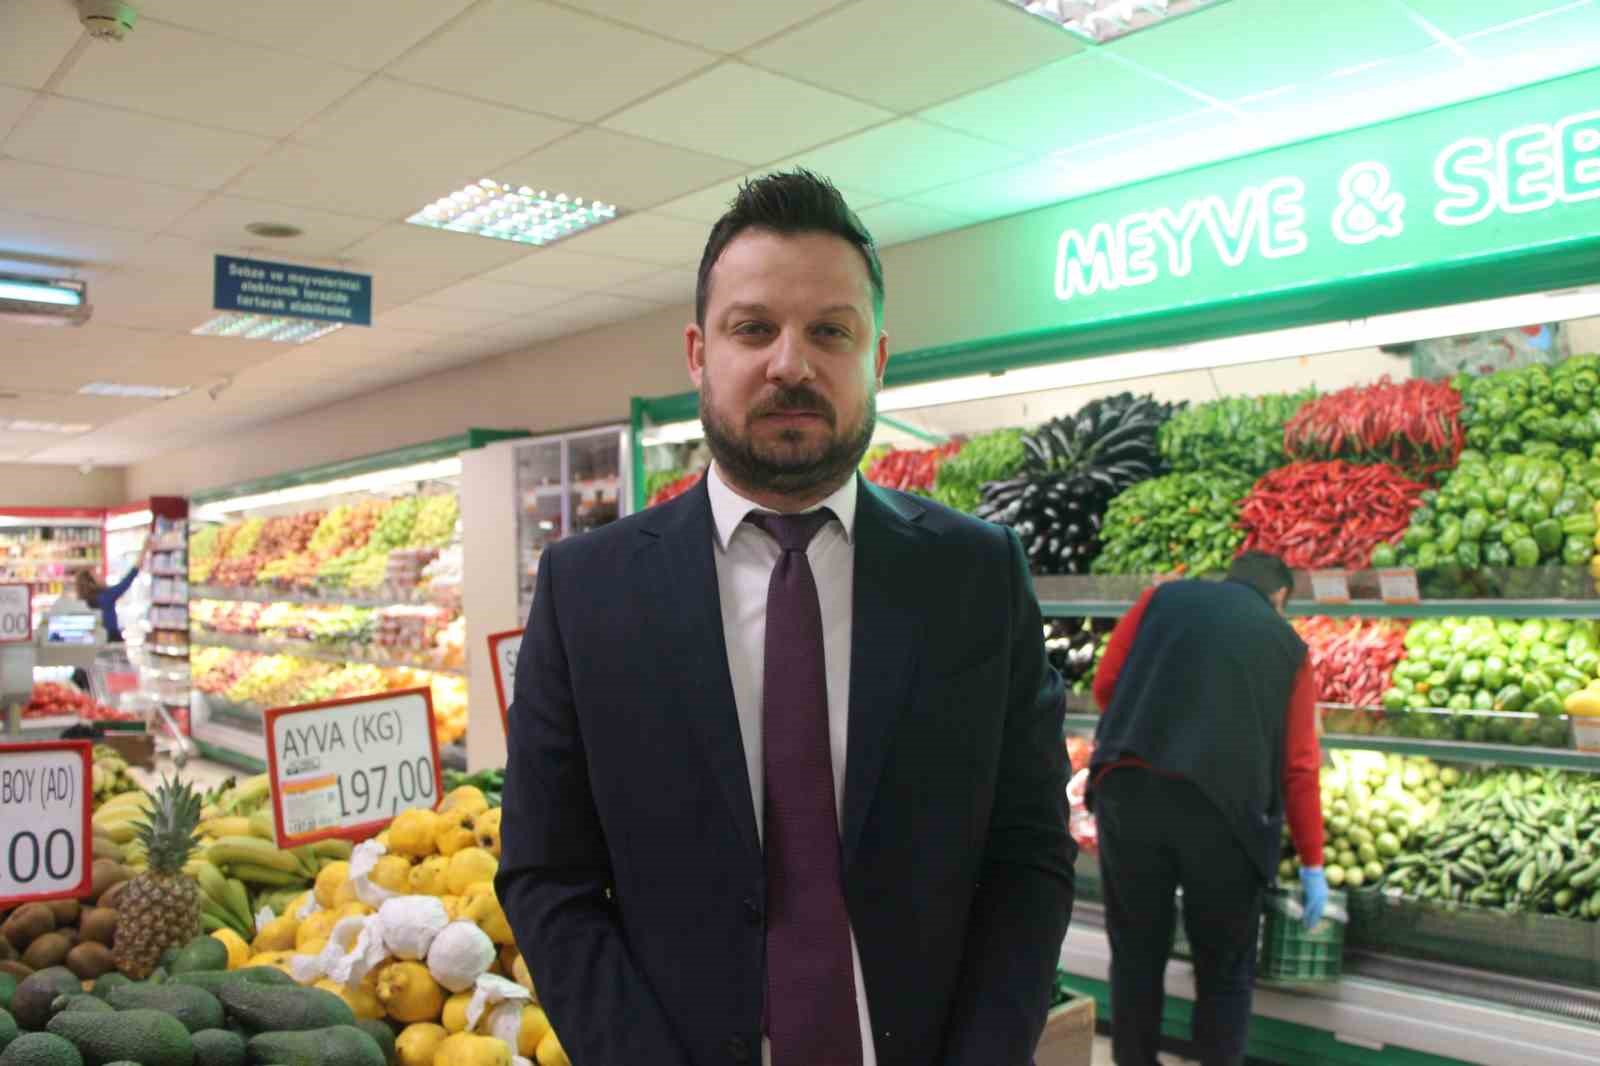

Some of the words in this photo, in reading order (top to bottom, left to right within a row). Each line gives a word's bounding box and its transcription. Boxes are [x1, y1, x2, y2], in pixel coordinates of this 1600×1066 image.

[1055, 177, 1307, 299] MEYVE
[1332, 161, 1405, 245] &
[1434, 109, 1600, 225] SEB
[270, 270, 284, 281] ve
[282, 720, 346, 760] AYVA
[353, 709, 404, 753] (KG)
[2, 767, 36, 804] BOY
[40, 764, 75, 809] (AD)
[336, 755, 434, 817] 197,00
[0, 827, 75, 884] 00
